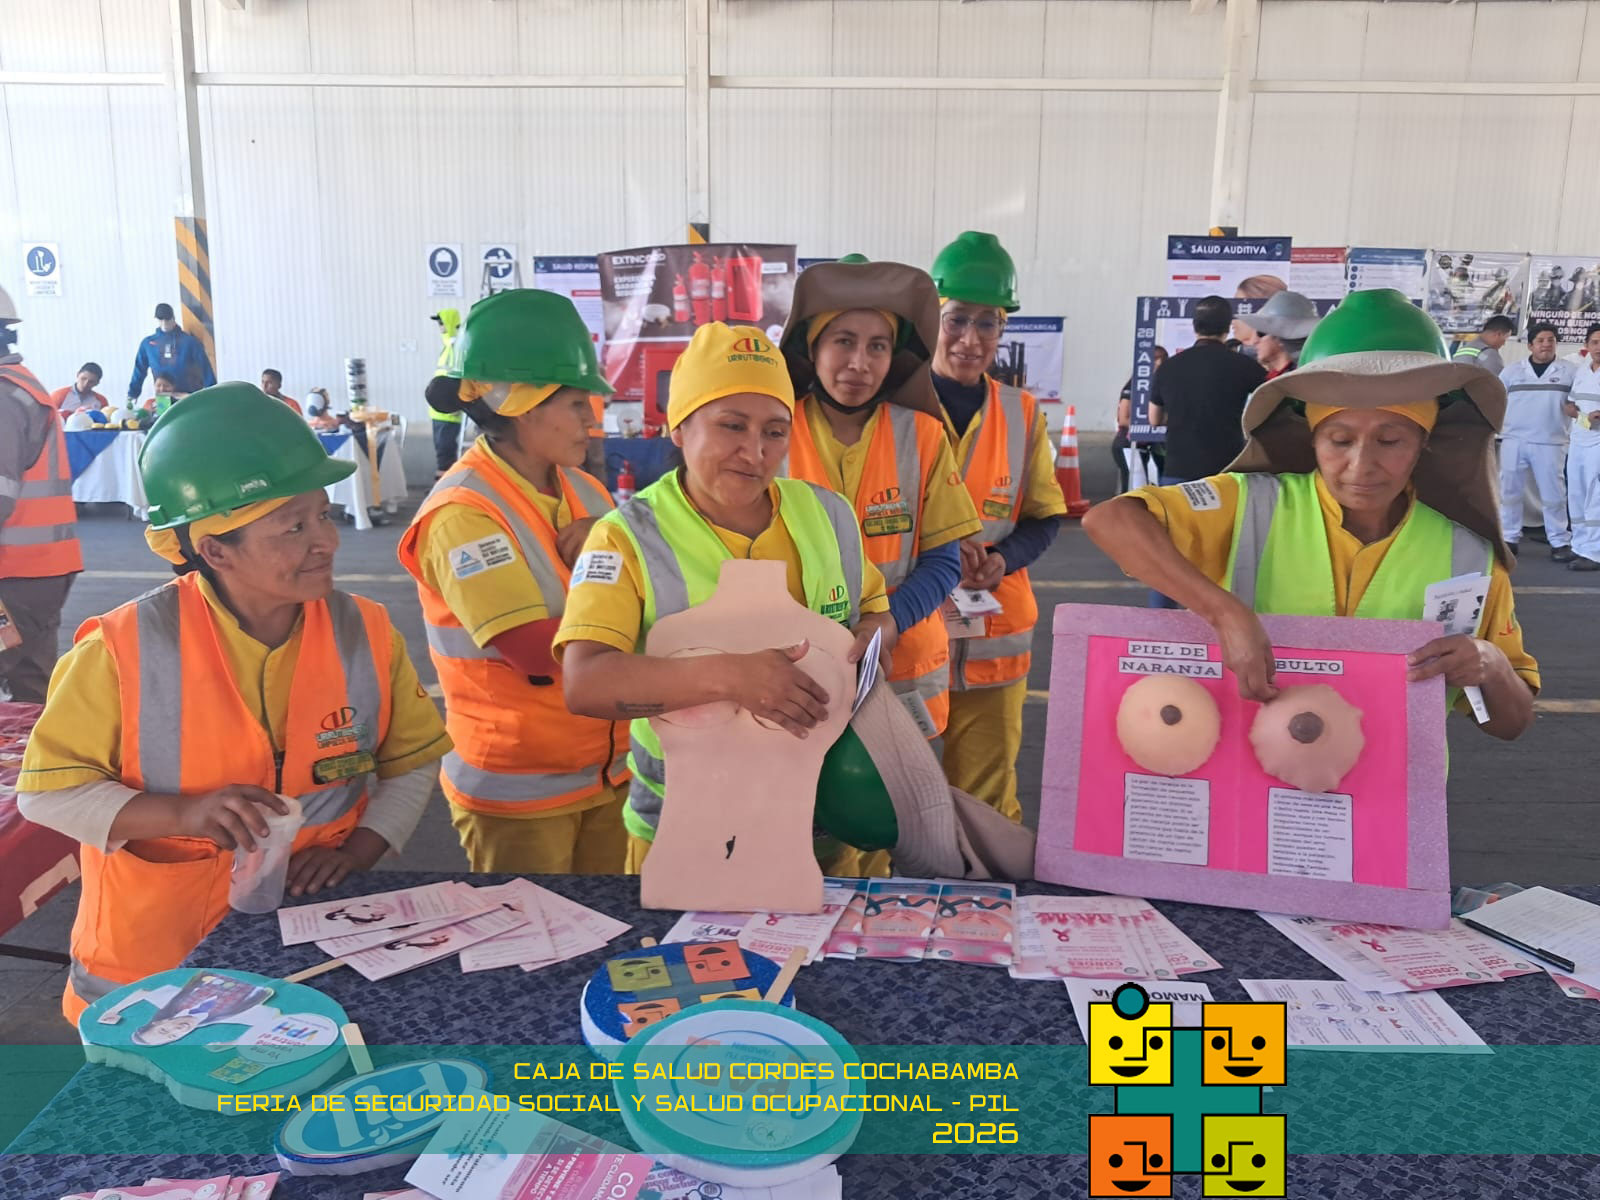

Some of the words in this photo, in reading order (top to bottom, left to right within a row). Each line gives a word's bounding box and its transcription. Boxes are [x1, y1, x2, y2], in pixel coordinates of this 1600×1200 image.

[1191, 245, 1221, 254] SALUD
[1223, 245, 1267, 255] AUDITIVA
[1137, 327, 1155, 338] 28
[1136, 351, 1151, 418] ABRIL
[1130, 643, 1175, 656] PIEL
[1180, 646, 1206, 657] DE
[1121, 660, 1220, 677] NARANJA
[1275, 660, 1341, 673] BULTO
[607, 1172, 634, 1200] CO
